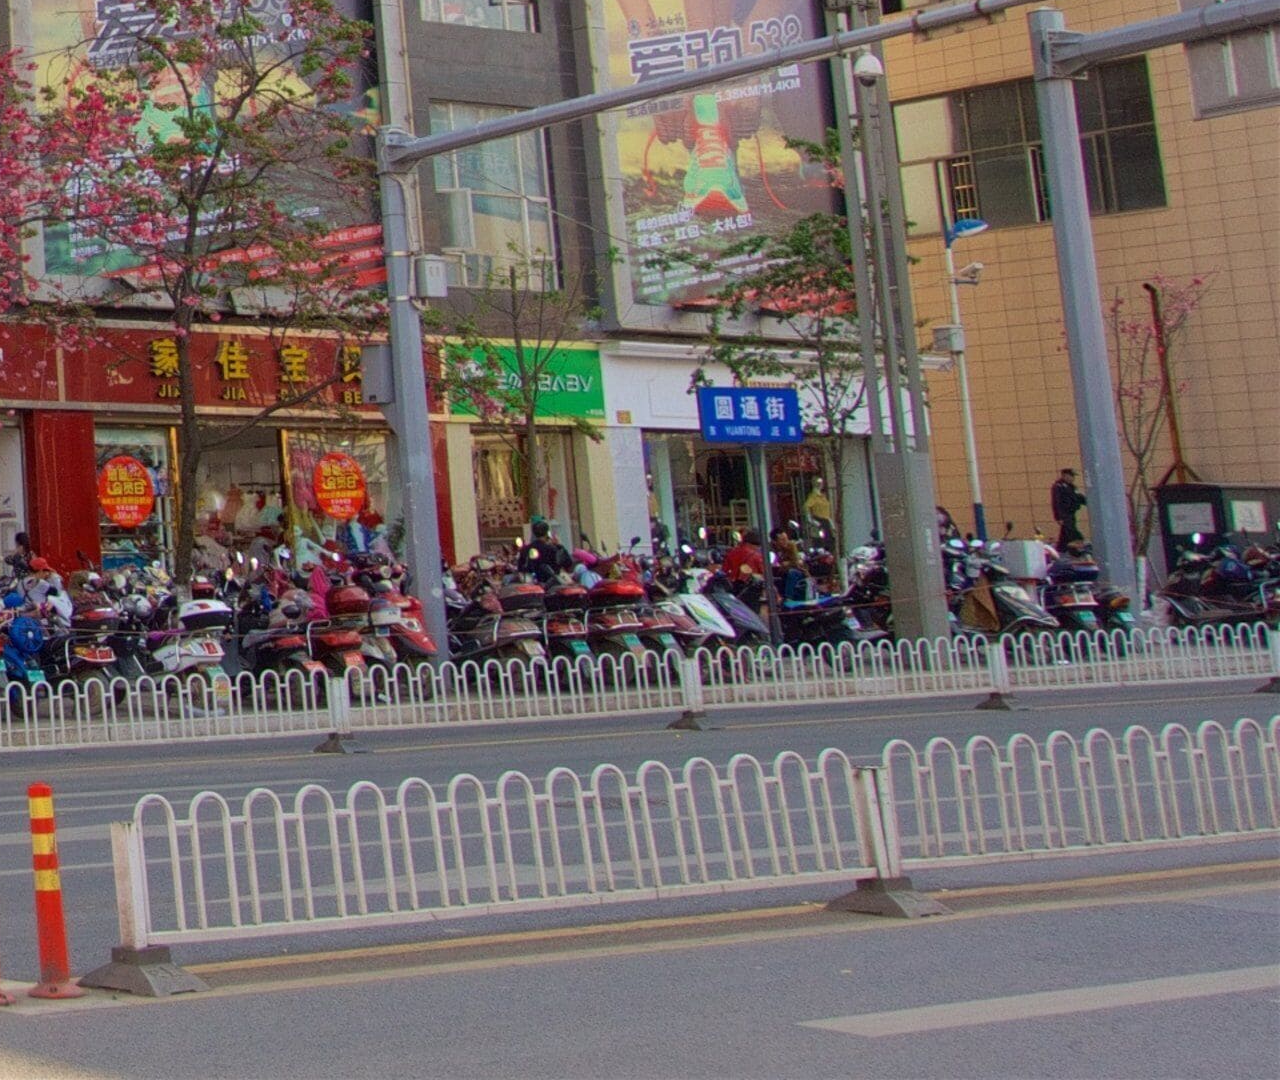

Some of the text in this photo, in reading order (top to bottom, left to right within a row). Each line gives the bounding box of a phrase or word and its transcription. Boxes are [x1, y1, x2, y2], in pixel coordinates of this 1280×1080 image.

[223, 386, 248, 401] JIA
[343, 392, 363, 405] BE
[713, 395, 785, 421] 圆通街
